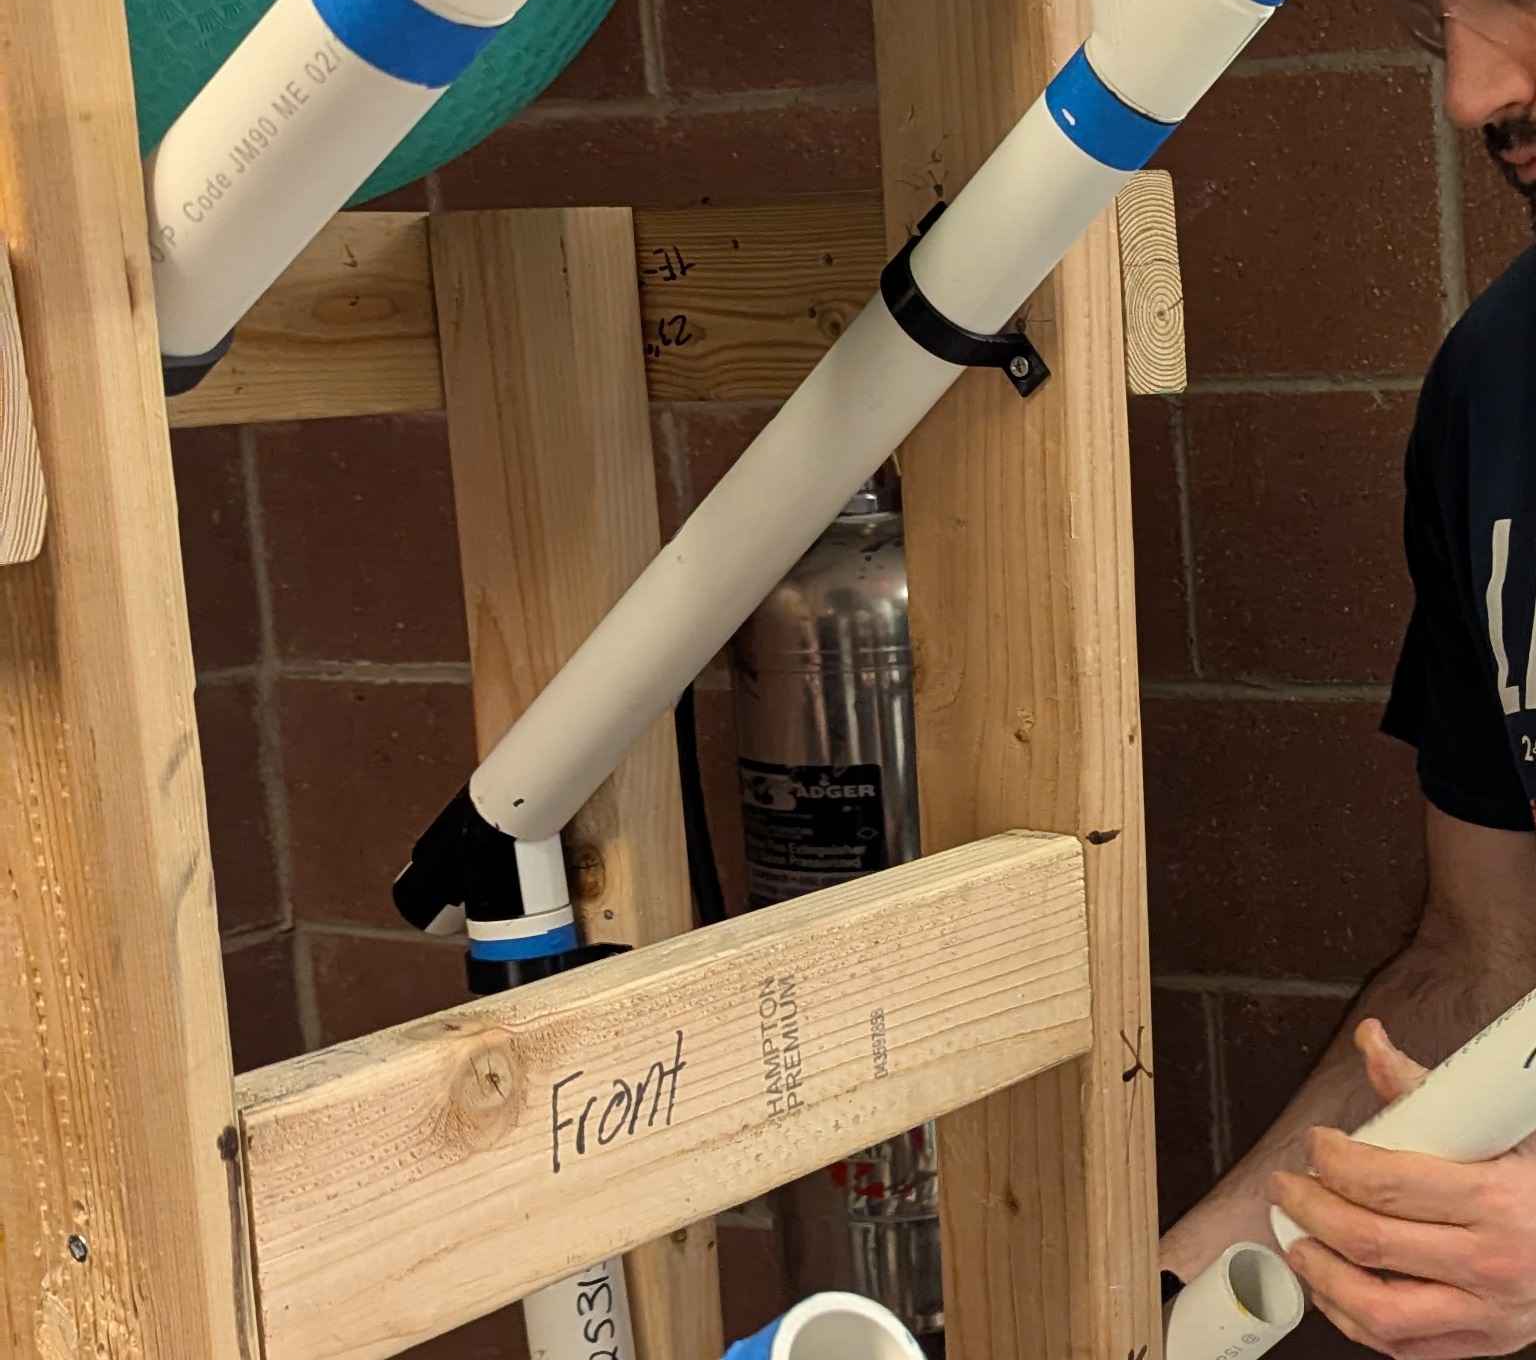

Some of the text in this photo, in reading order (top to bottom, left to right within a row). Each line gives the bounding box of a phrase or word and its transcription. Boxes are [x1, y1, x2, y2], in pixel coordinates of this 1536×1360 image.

[182, 170, 233, 224] Code
[271, 80, 313, 118] ME
[549, 1029, 687, 1174] Front
[762, 976, 788, 1123] HAMPTON
[779, 970, 806, 1114] PREMIUM
